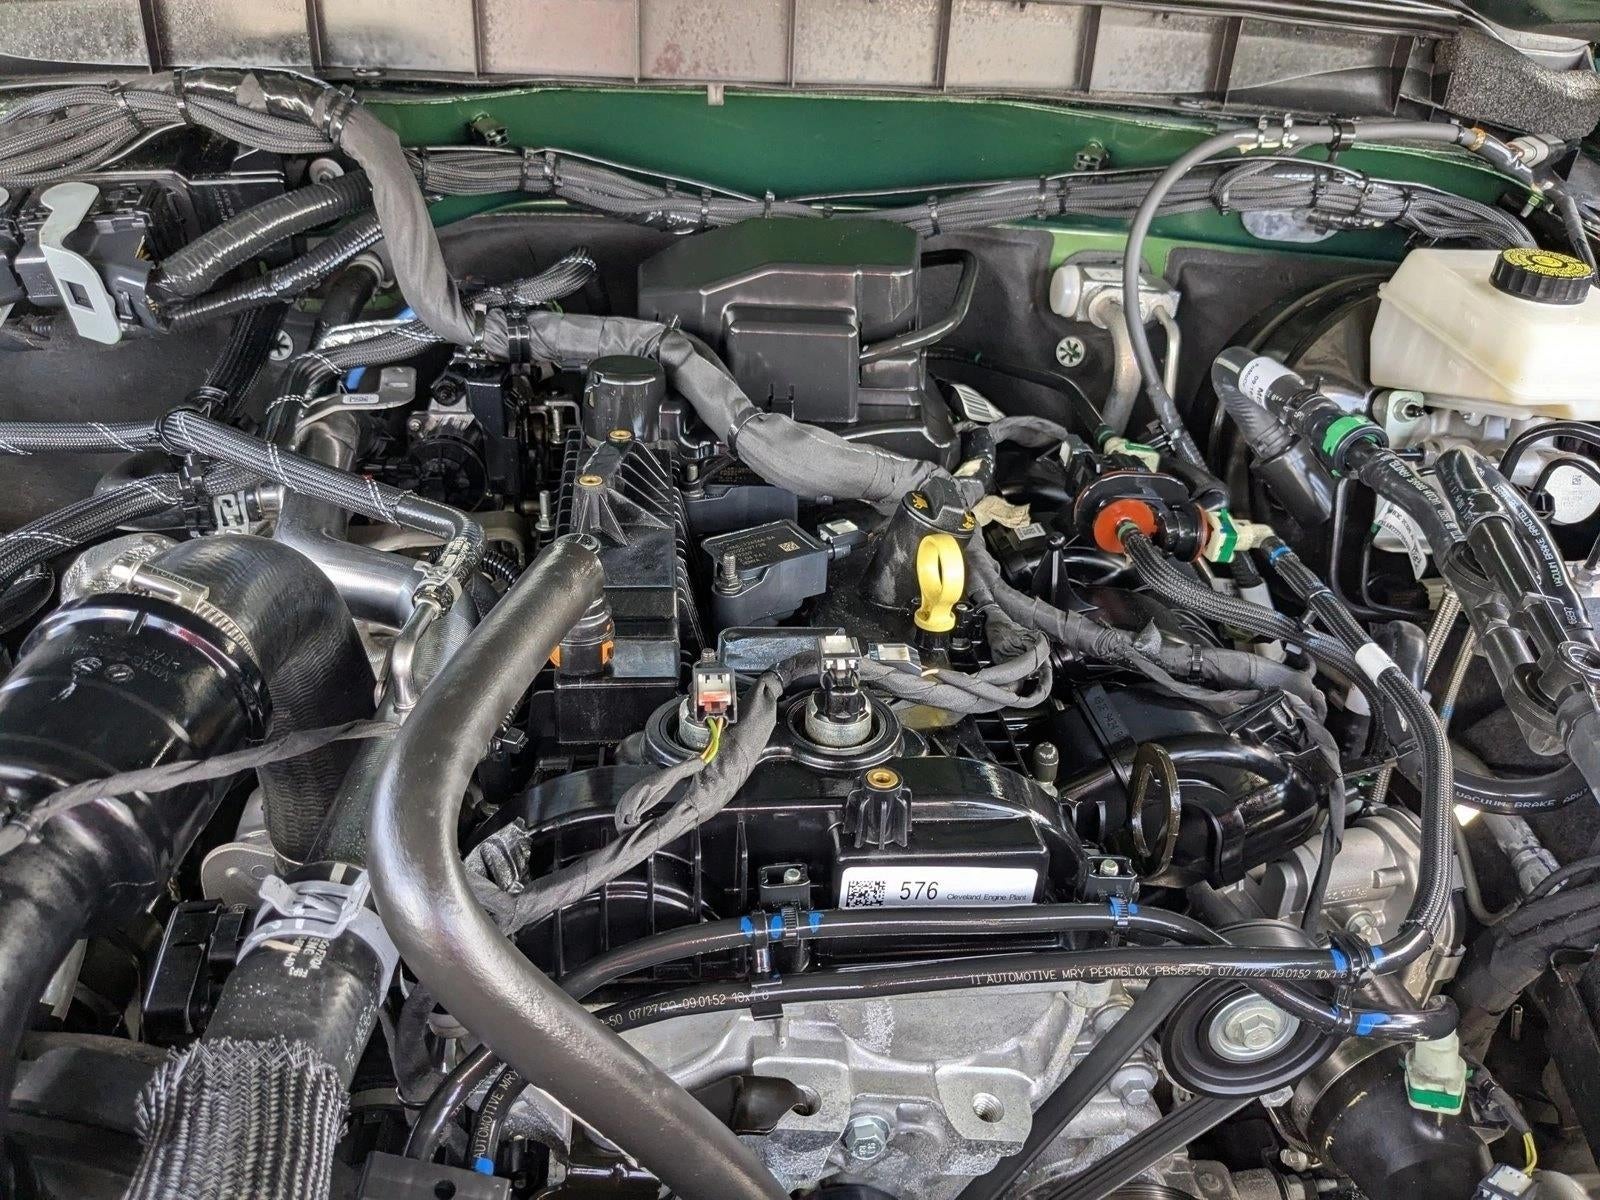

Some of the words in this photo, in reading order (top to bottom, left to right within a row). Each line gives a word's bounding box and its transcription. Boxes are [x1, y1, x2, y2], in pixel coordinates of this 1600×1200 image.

[1536, 537, 1554, 562] BRAKE
[1456, 790, 1507, 808] VACUUM
[1514, 799, 1556, 809] BRAKE
[899, 881, 939, 900] 576
[946, 893, 982, 901] Cleveland
[983, 893, 1007, 902] Engine
[1009, 893, 1028, 901] Plant
[986, 969, 1058, 984] AUTOMOTIVE
[1062, 966, 1087, 980] MRY
[1090, 964, 1150, 978] PERMBLOK
[1154, 966, 1211, 976] PB562-50
[1217, 966, 1267, 977] 07/27/22
[628, 1000, 676, 1021] 07/27/22
[473, 1090, 505, 1158] AUTOMOTIVE
[499, 1068, 519, 1091] MRY
